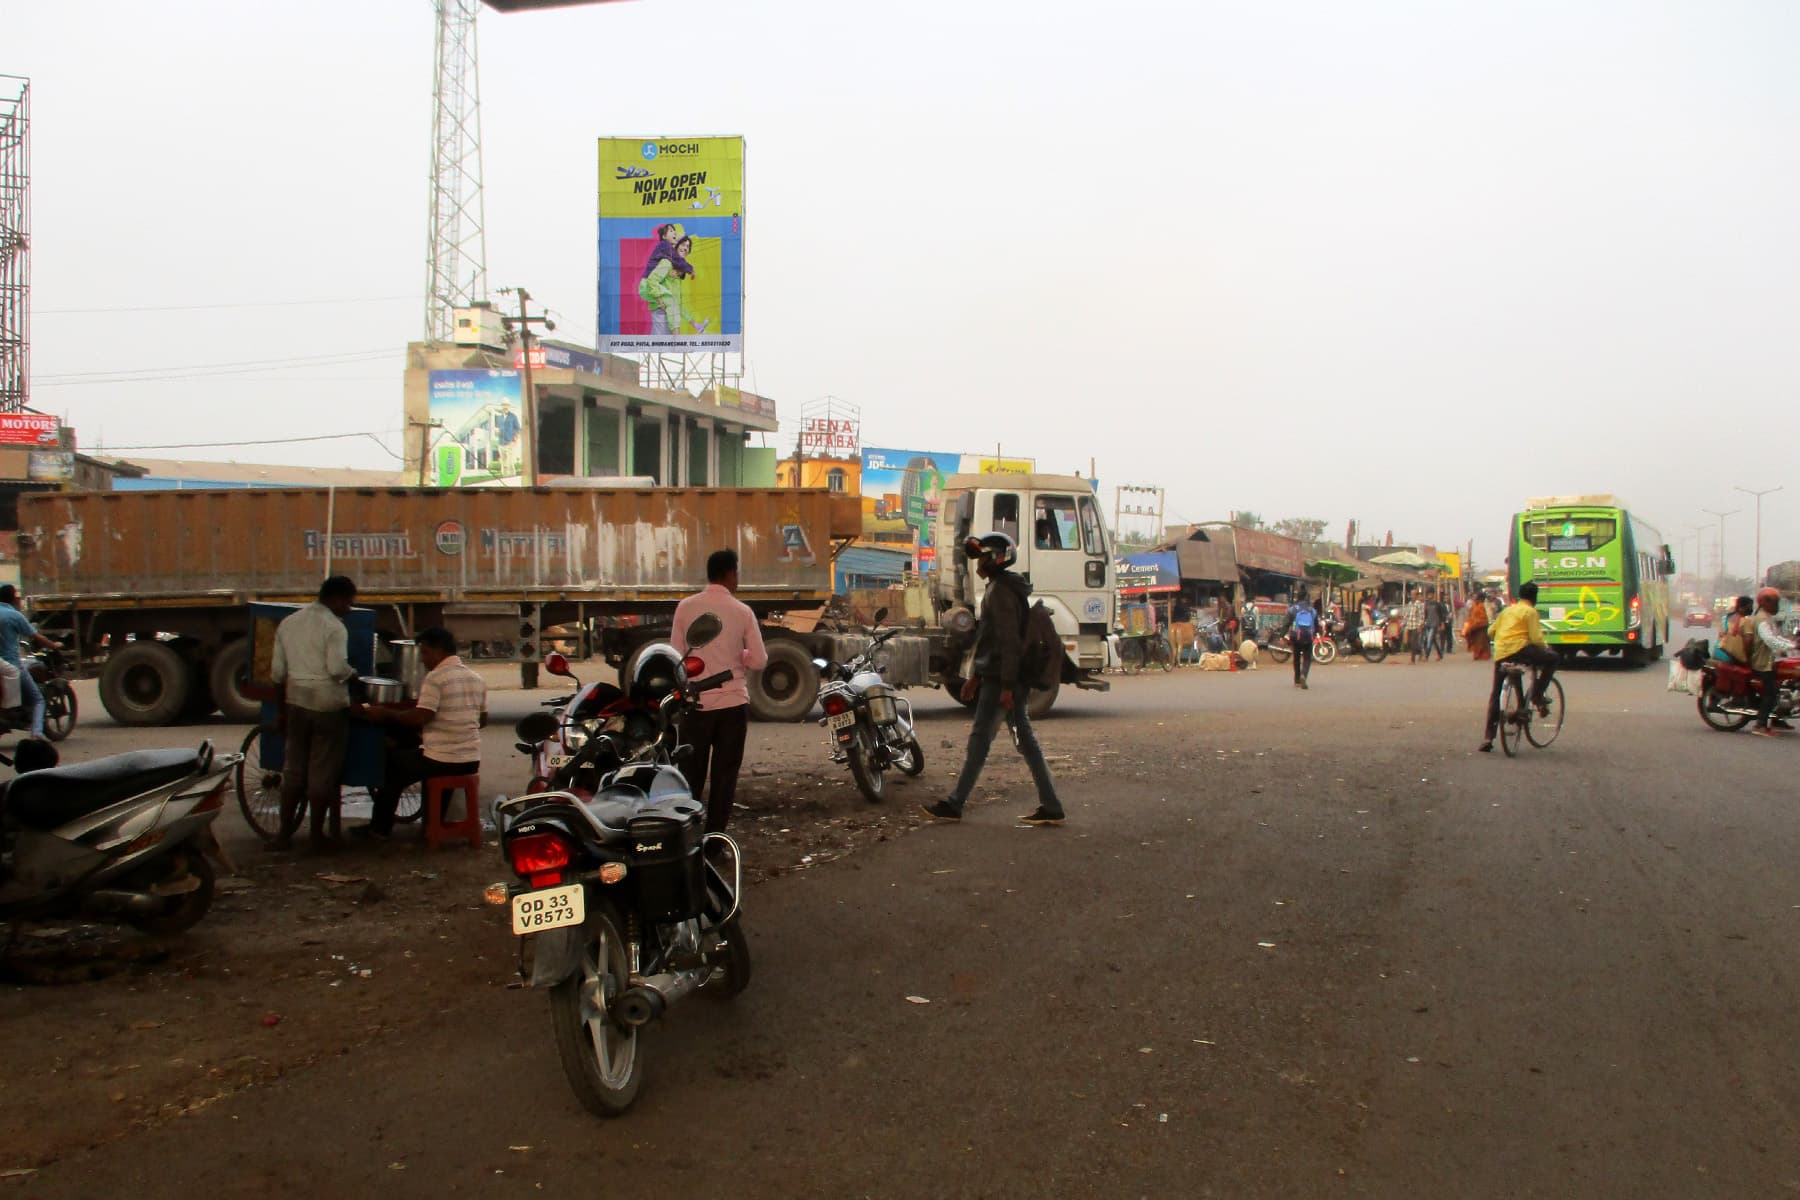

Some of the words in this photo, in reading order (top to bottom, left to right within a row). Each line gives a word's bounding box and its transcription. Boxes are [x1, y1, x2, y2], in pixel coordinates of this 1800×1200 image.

[659, 143, 699, 154] MOCHI
[633, 176, 667, 194] NOW
[670, 171, 707, 189] OPEN
[641, 191, 657, 206] IN
[659, 186, 697, 204] PATIA
[1, 419, 58, 431] MOTORS
[807, 418, 852, 433] JENA
[804, 433, 855, 448] DHABA
[1131, 563, 1159, 573] Cement
[520, 900, 544, 914] OD
[549, 894, 569, 909] 33
[520, 907, 575, 928] V8573
